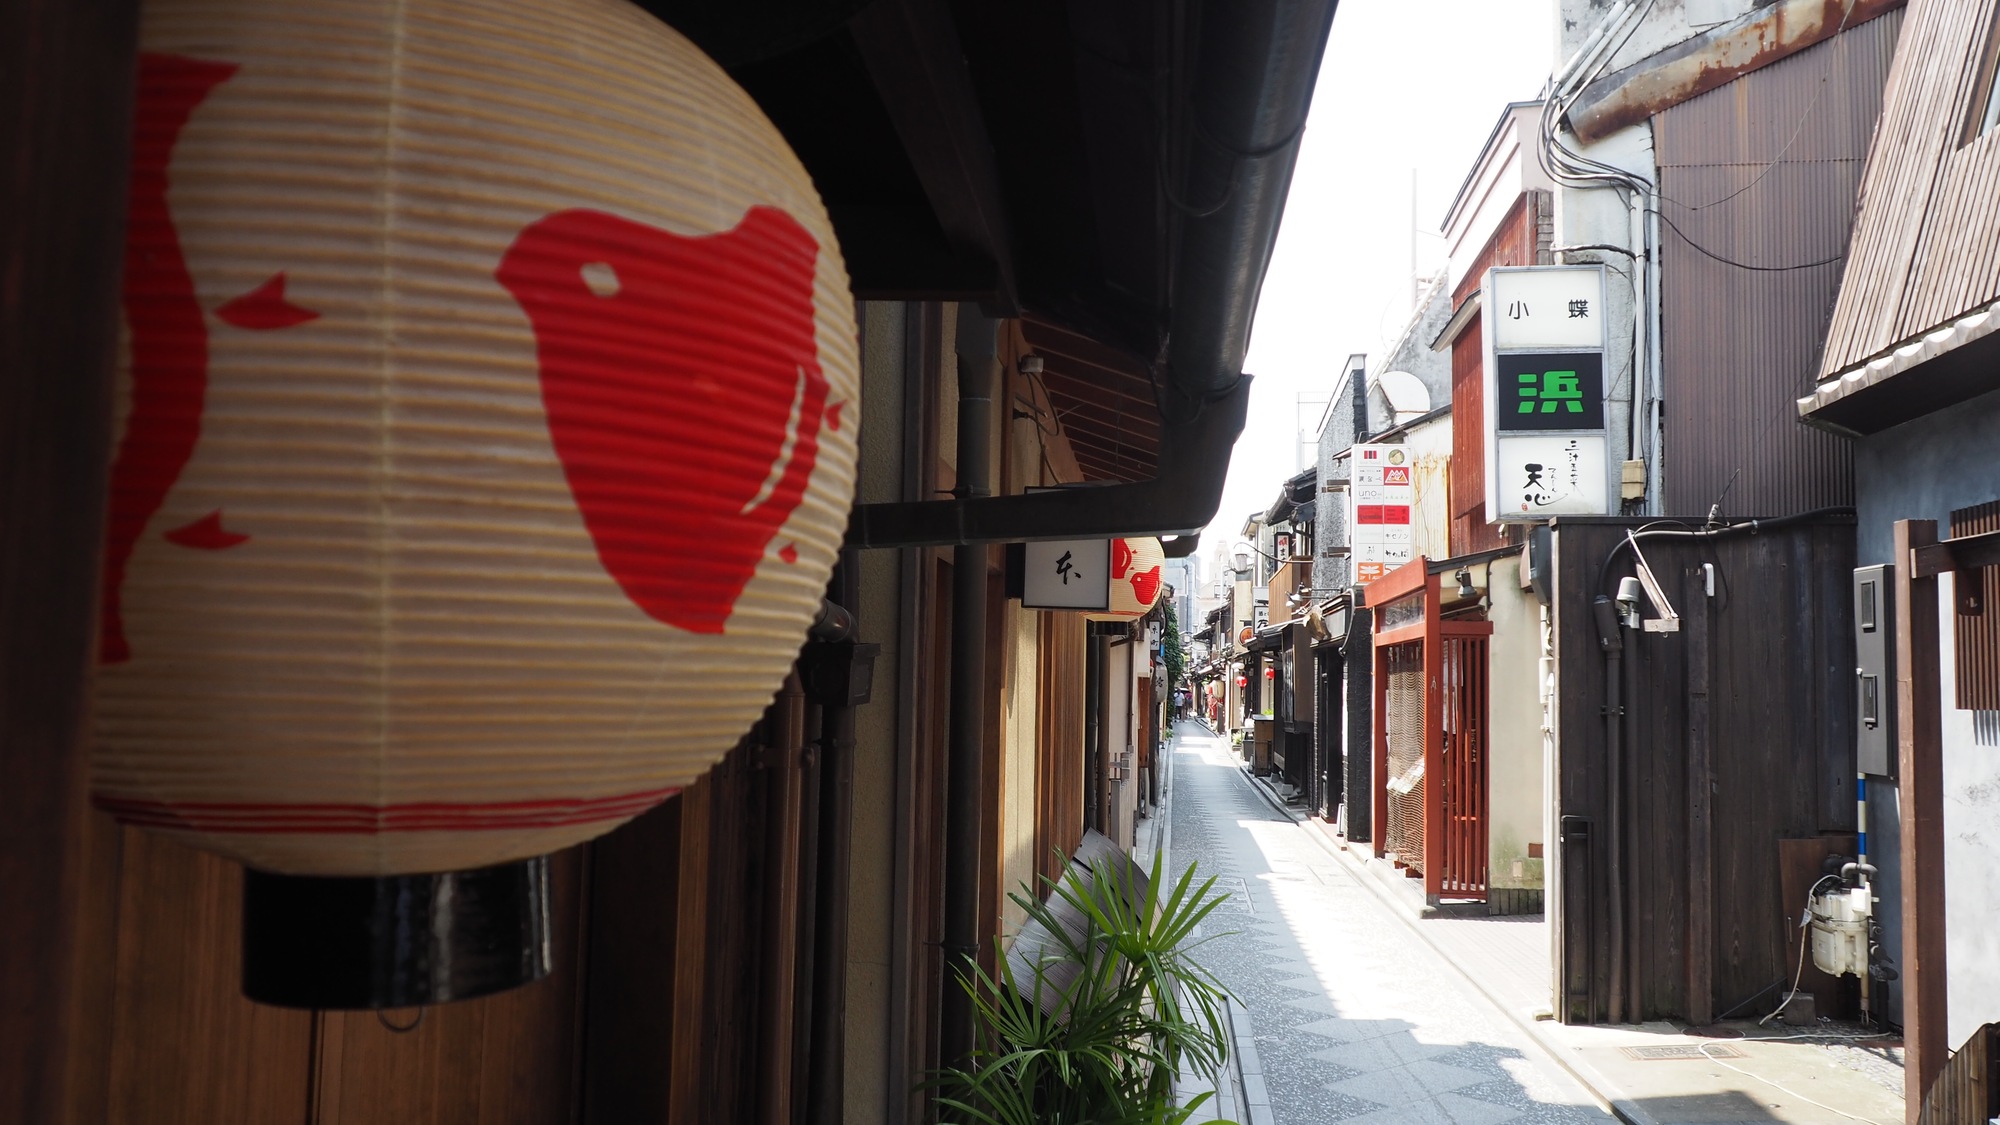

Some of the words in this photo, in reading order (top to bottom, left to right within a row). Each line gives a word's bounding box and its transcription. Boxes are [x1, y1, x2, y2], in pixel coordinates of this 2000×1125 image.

[1508, 299, 1589, 320] 小蝶
[1517, 370, 1584, 414] 浜
[1522, 463, 1567, 507] 天心
